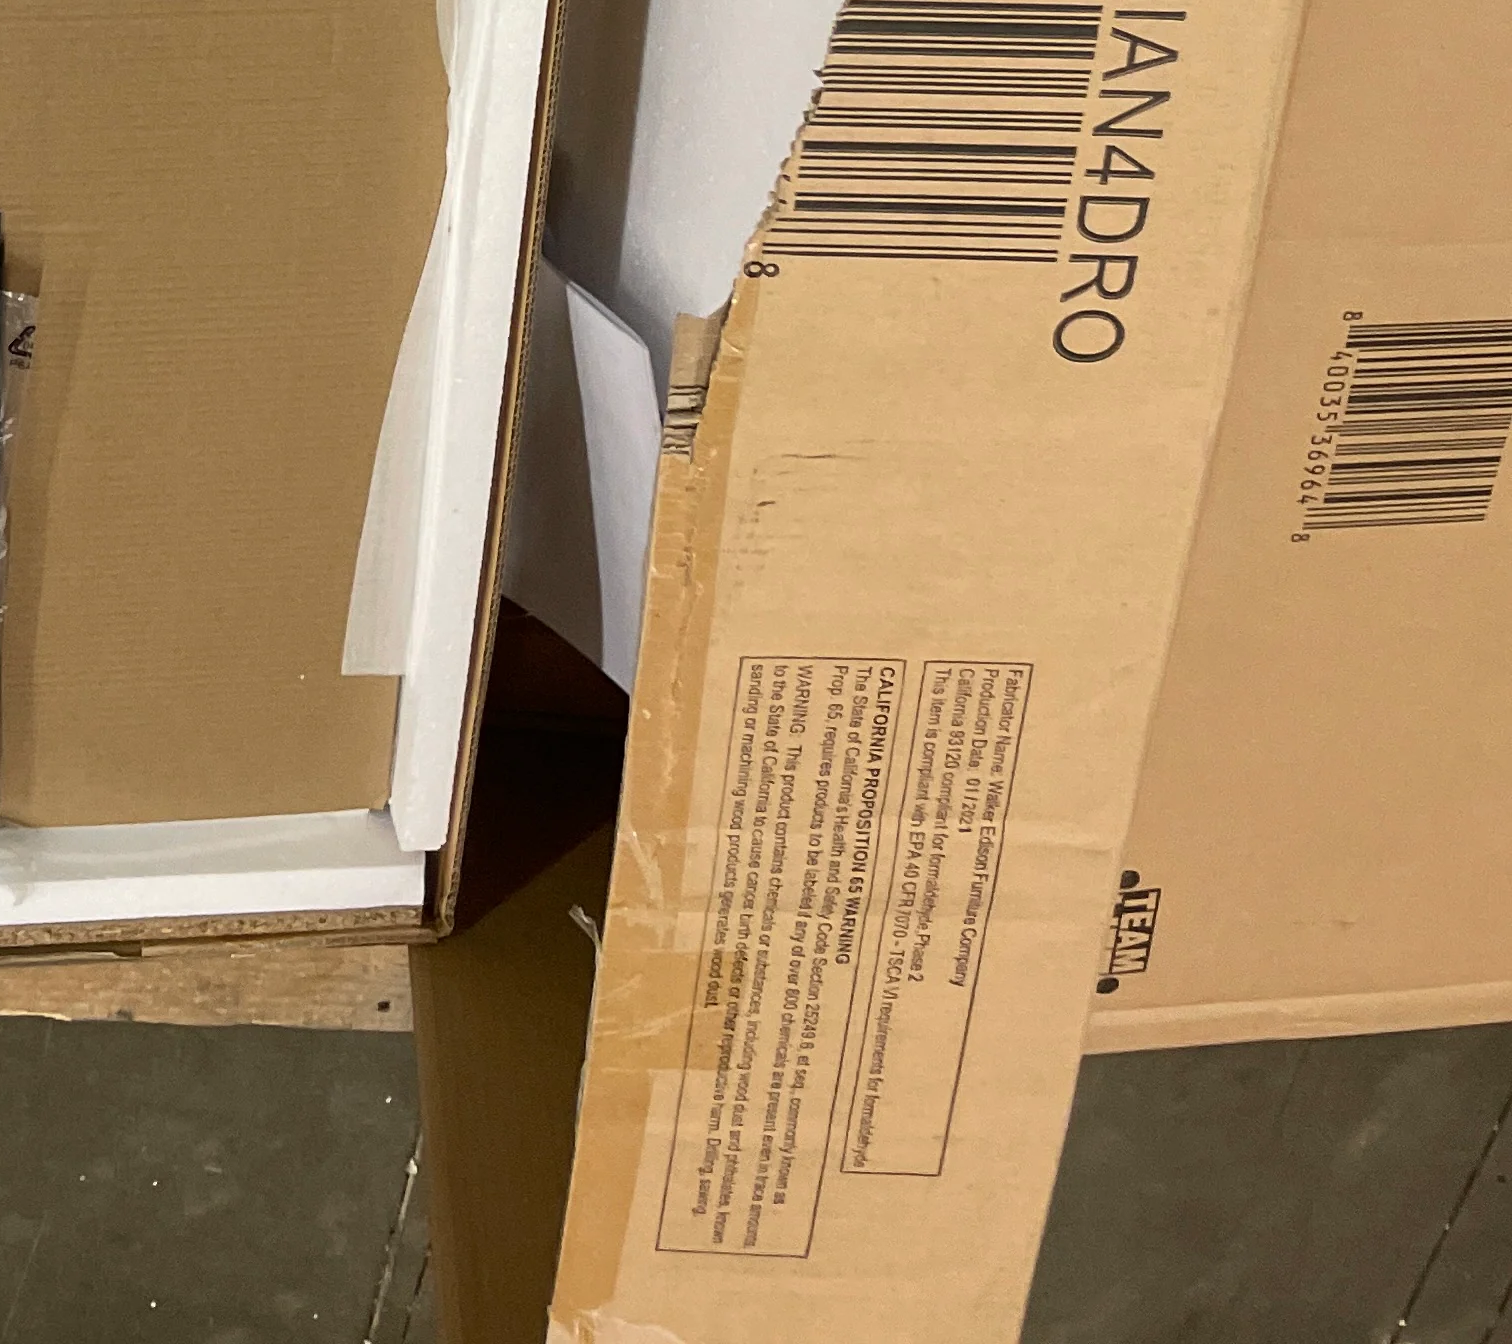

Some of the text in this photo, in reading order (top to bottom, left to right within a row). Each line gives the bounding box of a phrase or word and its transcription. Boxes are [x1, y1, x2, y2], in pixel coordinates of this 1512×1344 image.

[742, 259, 781, 279] 8
[1290, 310, 1364, 543] 8 40035 36964 8
[774, 664, 789, 677] to
[854, 666, 872, 691] The
[931, 668, 952, 694] This
[742, 664, 763, 713] sanding
[770, 680, 786, 700] the
[951, 668, 974, 726] California
[974, 668, 999, 735] Production
[998, 669, 1023, 732] Fabricator
[743, 717, 756, 730] or
[765, 704, 784, 736] State
[848, 695, 868, 727] State
[928, 698, 946, 725] item
[763, 740, 778, 752] of
[846, 731, 862, 744] of
[924, 728, 941, 738] is
[731, 733, 753, 796] machining
[783, 745, 802, 770] This
[818, 726, 836, 776] requires
[944, 730, 965, 769] 93120
[755, 756, 777, 812] California
[836, 747, 860, 812] California's
[916, 741, 935, 800] compliant
[776, 774, 794, 819] product
[809, 779, 829, 829] products
[934, 771, 953, 829] compliant
[981, 780, 1003, 822] Walker
[729, 799, 744, 829] wood
[752, 816, 768, 827] to
[835, 667, 894, 964] CALIFORNIA PROPOSITION 65 WARNING
[910, 803, 928, 827] with
[748, 828, 763, 868] cause
[770, 821, 787, 874] contains
[808, 833, 823, 846] to
[830, 815, 849, 857] Health
[906, 831, 925, 859] EPA
[931, 833, 948, 850] for
[974, 826, 995, 870] Edison
[723, 834, 740, 887] products
[806, 850, 821, 865] be
[826, 860, 840, 882] and
[903, 862, 920, 877] 40
[761, 877, 782, 931] chemicals
[816, 886, 838, 919] Safety
[898, 881, 916, 907] CFR
[963, 873, 987, 924] Furniture
[758, 933, 770, 947] or
[789, 921, 807, 942] any
[813, 922, 832, 954] Code
[1111, 891, 1159, 973] TEAM
[708, 948, 723, 979] wood
[730, 942, 748, 984] defects
[791, 945, 805, 957] of
[885, 950, 905, 983] TSCA
[910, 933, 930, 971] Phase
[949, 927, 976, 987] Company
[787, 959, 801, 985] over
[807, 957, 827, 1000] Section
[907, 973, 924, 982] 2
[728, 986, 743, 999] or
[723, 1001, 740, 1030] other
[736, 1020, 759, 1069] including
[869, 1001, 892, 1074] requirements
[734, 1072, 749, 1101] wood
[770, 1071, 784, 1089] are
[866, 1077, 883, 1092] for
[731, 1103, 747, 1126] dust
[763, 1091, 780, 1131] present
[727, 1130, 742, 1151] and
[852, 1094, 879, 1167] formaldehyde
[752, 1176, 768, 1201] trace
